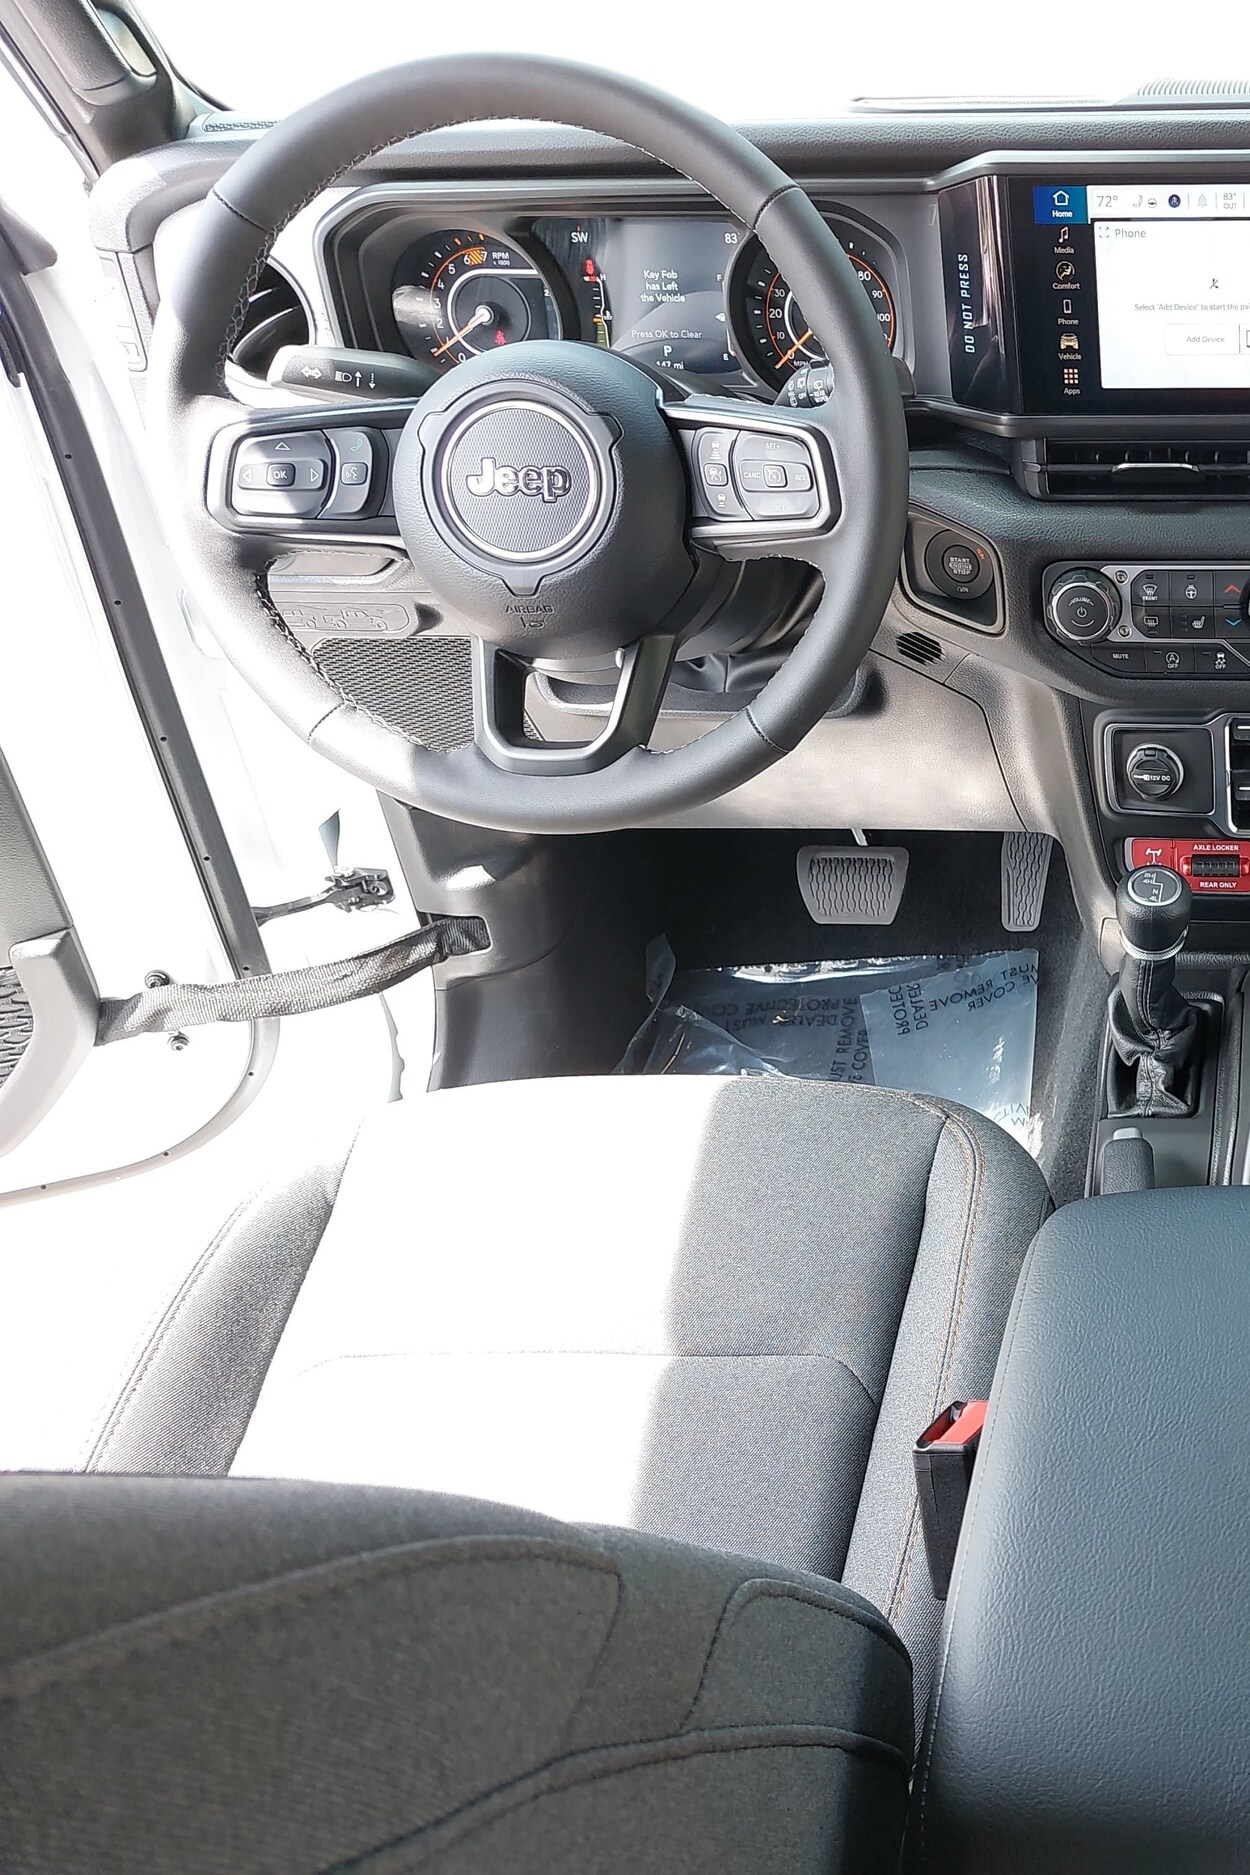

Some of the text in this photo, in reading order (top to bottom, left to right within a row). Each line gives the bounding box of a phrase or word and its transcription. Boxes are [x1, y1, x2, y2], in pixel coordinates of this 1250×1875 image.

[1052, 210, 1073, 218] Home
[571, 232, 588, 243] SW
[1115, 229, 1146, 238] Phone
[1054, 246, 1075, 254] Media
[463, 255, 471, 265] 6
[481, 251, 488, 262] 7
[492, 252, 510, 260] RPM
[449, 264, 456, 274] 5
[643, 269, 678, 280] Key Fob
[437, 279, 445, 290] 4
[645, 281, 678, 291] has Left
[1053, 282, 1080, 290] Comfort
[640, 293, 686, 303] the Vehicle
[773, 288, 786, 298] 30
[872, 290, 883, 299] 90
[434, 298, 441, 309] 3
[957, 254, 976, 353] DO NOT PRESS
[769, 308, 782, 319] 20
[876, 313, 891, 322] 100
[436, 318, 444, 329] 2
[631, 330, 702, 339] Press OK to Clear
[776, 331, 786, 340] 10
[663, 345, 672, 357] P
[1058, 352, 1082, 360] Vehicle
[458, 352, 466, 363] 0
[1064, 387, 1080, 395] Apps
[273, 470, 288, 480] OK
[466, 457, 572, 503] Jeep
[743, 471, 761, 479] CANC
[505, 604, 554, 615] AIRBAG
